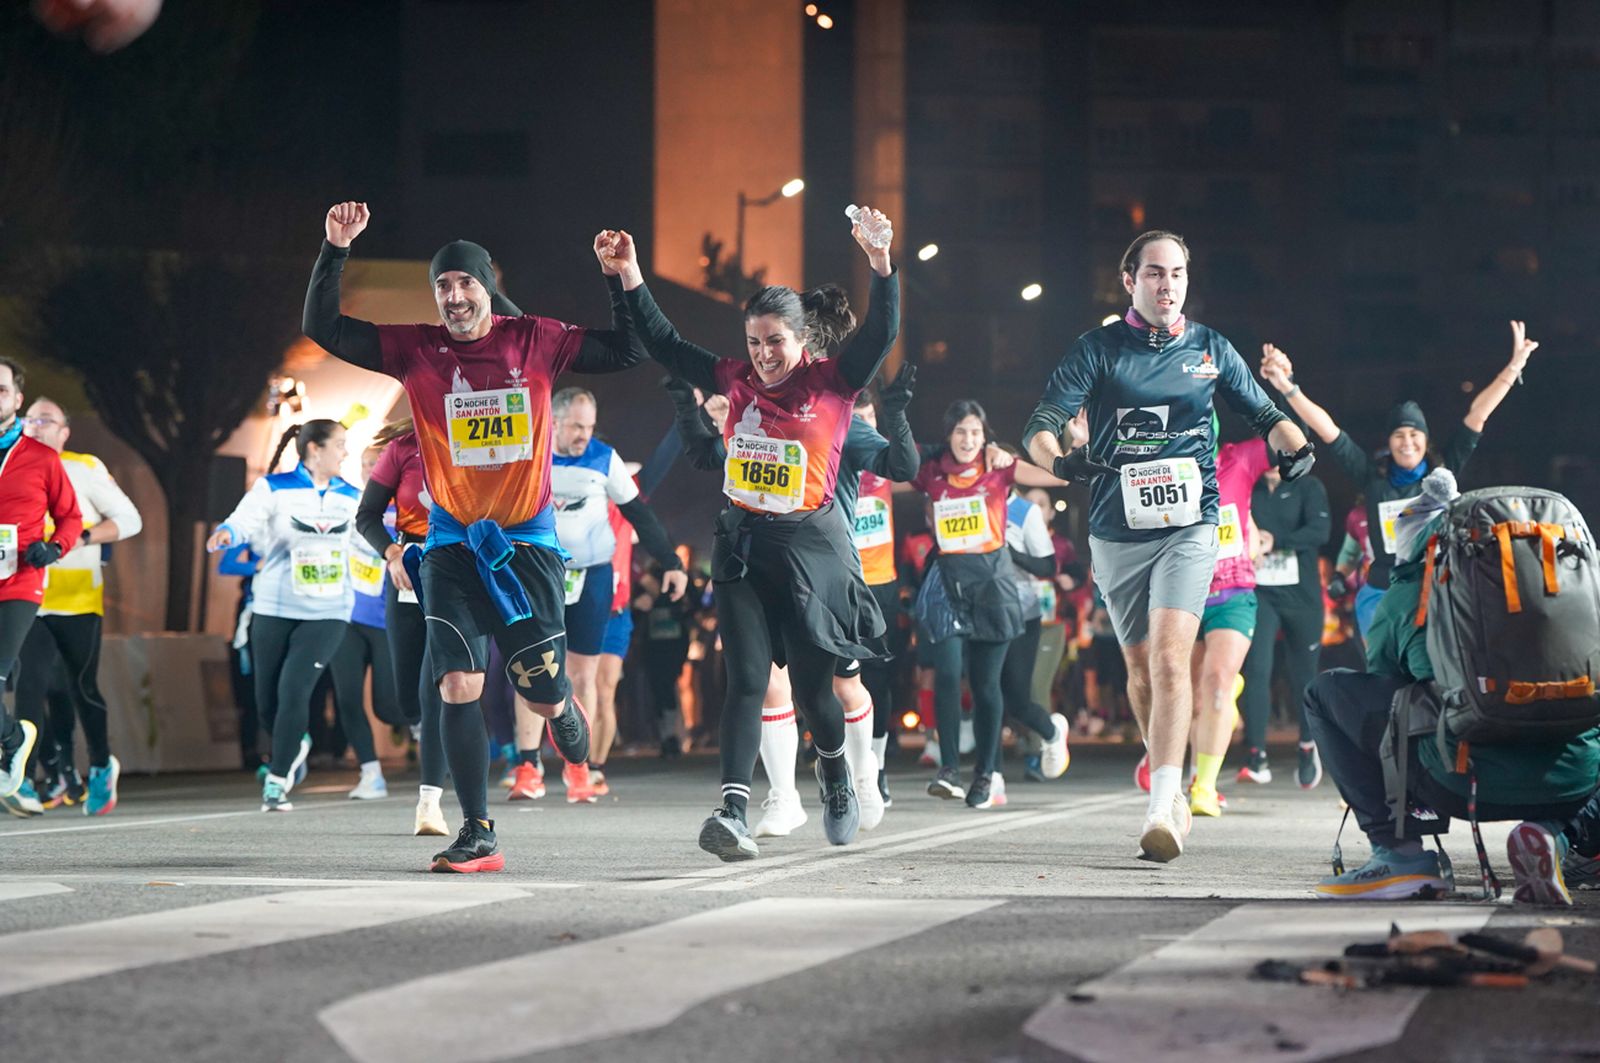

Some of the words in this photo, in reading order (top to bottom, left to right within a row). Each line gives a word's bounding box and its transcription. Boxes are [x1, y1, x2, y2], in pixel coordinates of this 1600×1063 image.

[464, 400, 488, 408] NOCHE
[456, 410, 472, 418] SAN
[467, 416, 513, 440] 2741
[745, 442, 768, 451] NOCHE
[737, 450, 752, 459] SAN
[741, 461, 790, 488] 1856
[1138, 469, 1161, 477] NOCHE
[1131, 479, 1146, 487] SAN
[1139, 483, 1188, 507] 5051
[855, 513, 884, 532] 2394
[945, 515, 978, 533] 12217
[1354, 864, 1391, 880] HOKA
